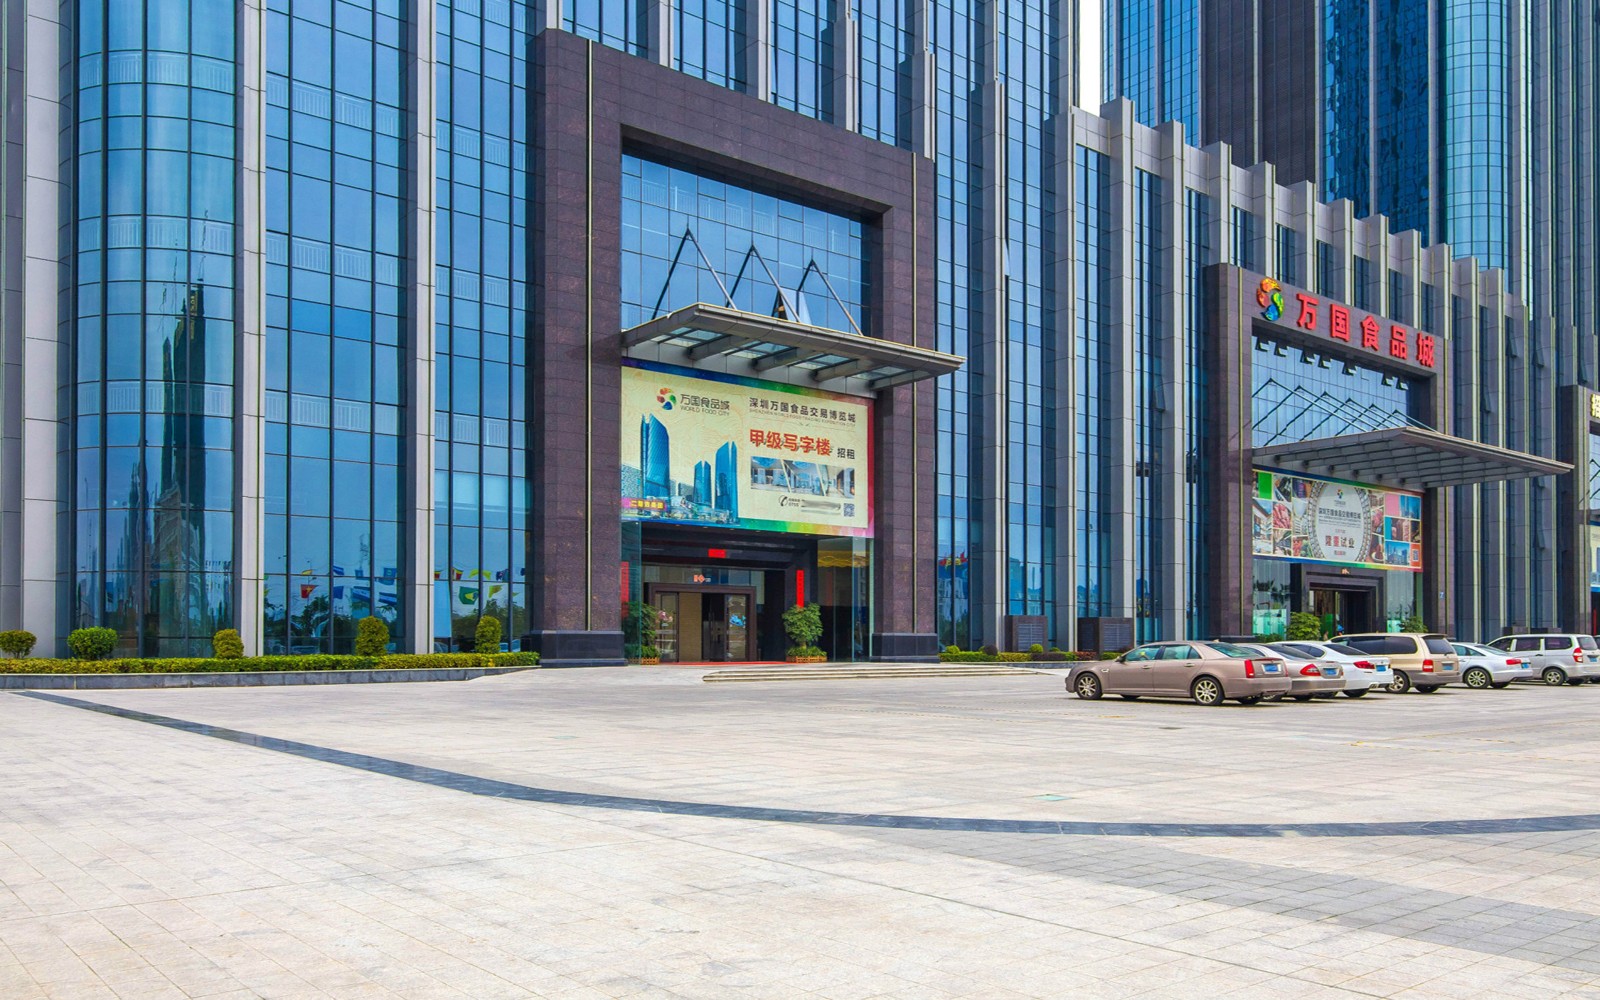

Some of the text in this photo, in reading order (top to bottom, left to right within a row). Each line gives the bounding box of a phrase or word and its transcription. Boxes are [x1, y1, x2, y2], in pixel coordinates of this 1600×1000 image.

[1296, 293, 1435, 368] 万国食品城
[680, 394, 730, 410] 万国食品城
[681, 405, 700, 413] WORLD
[749, 397, 856, 422] 深圳万国食品交易博览城
[750, 429, 855, 460] 甲级写字楼 招租
